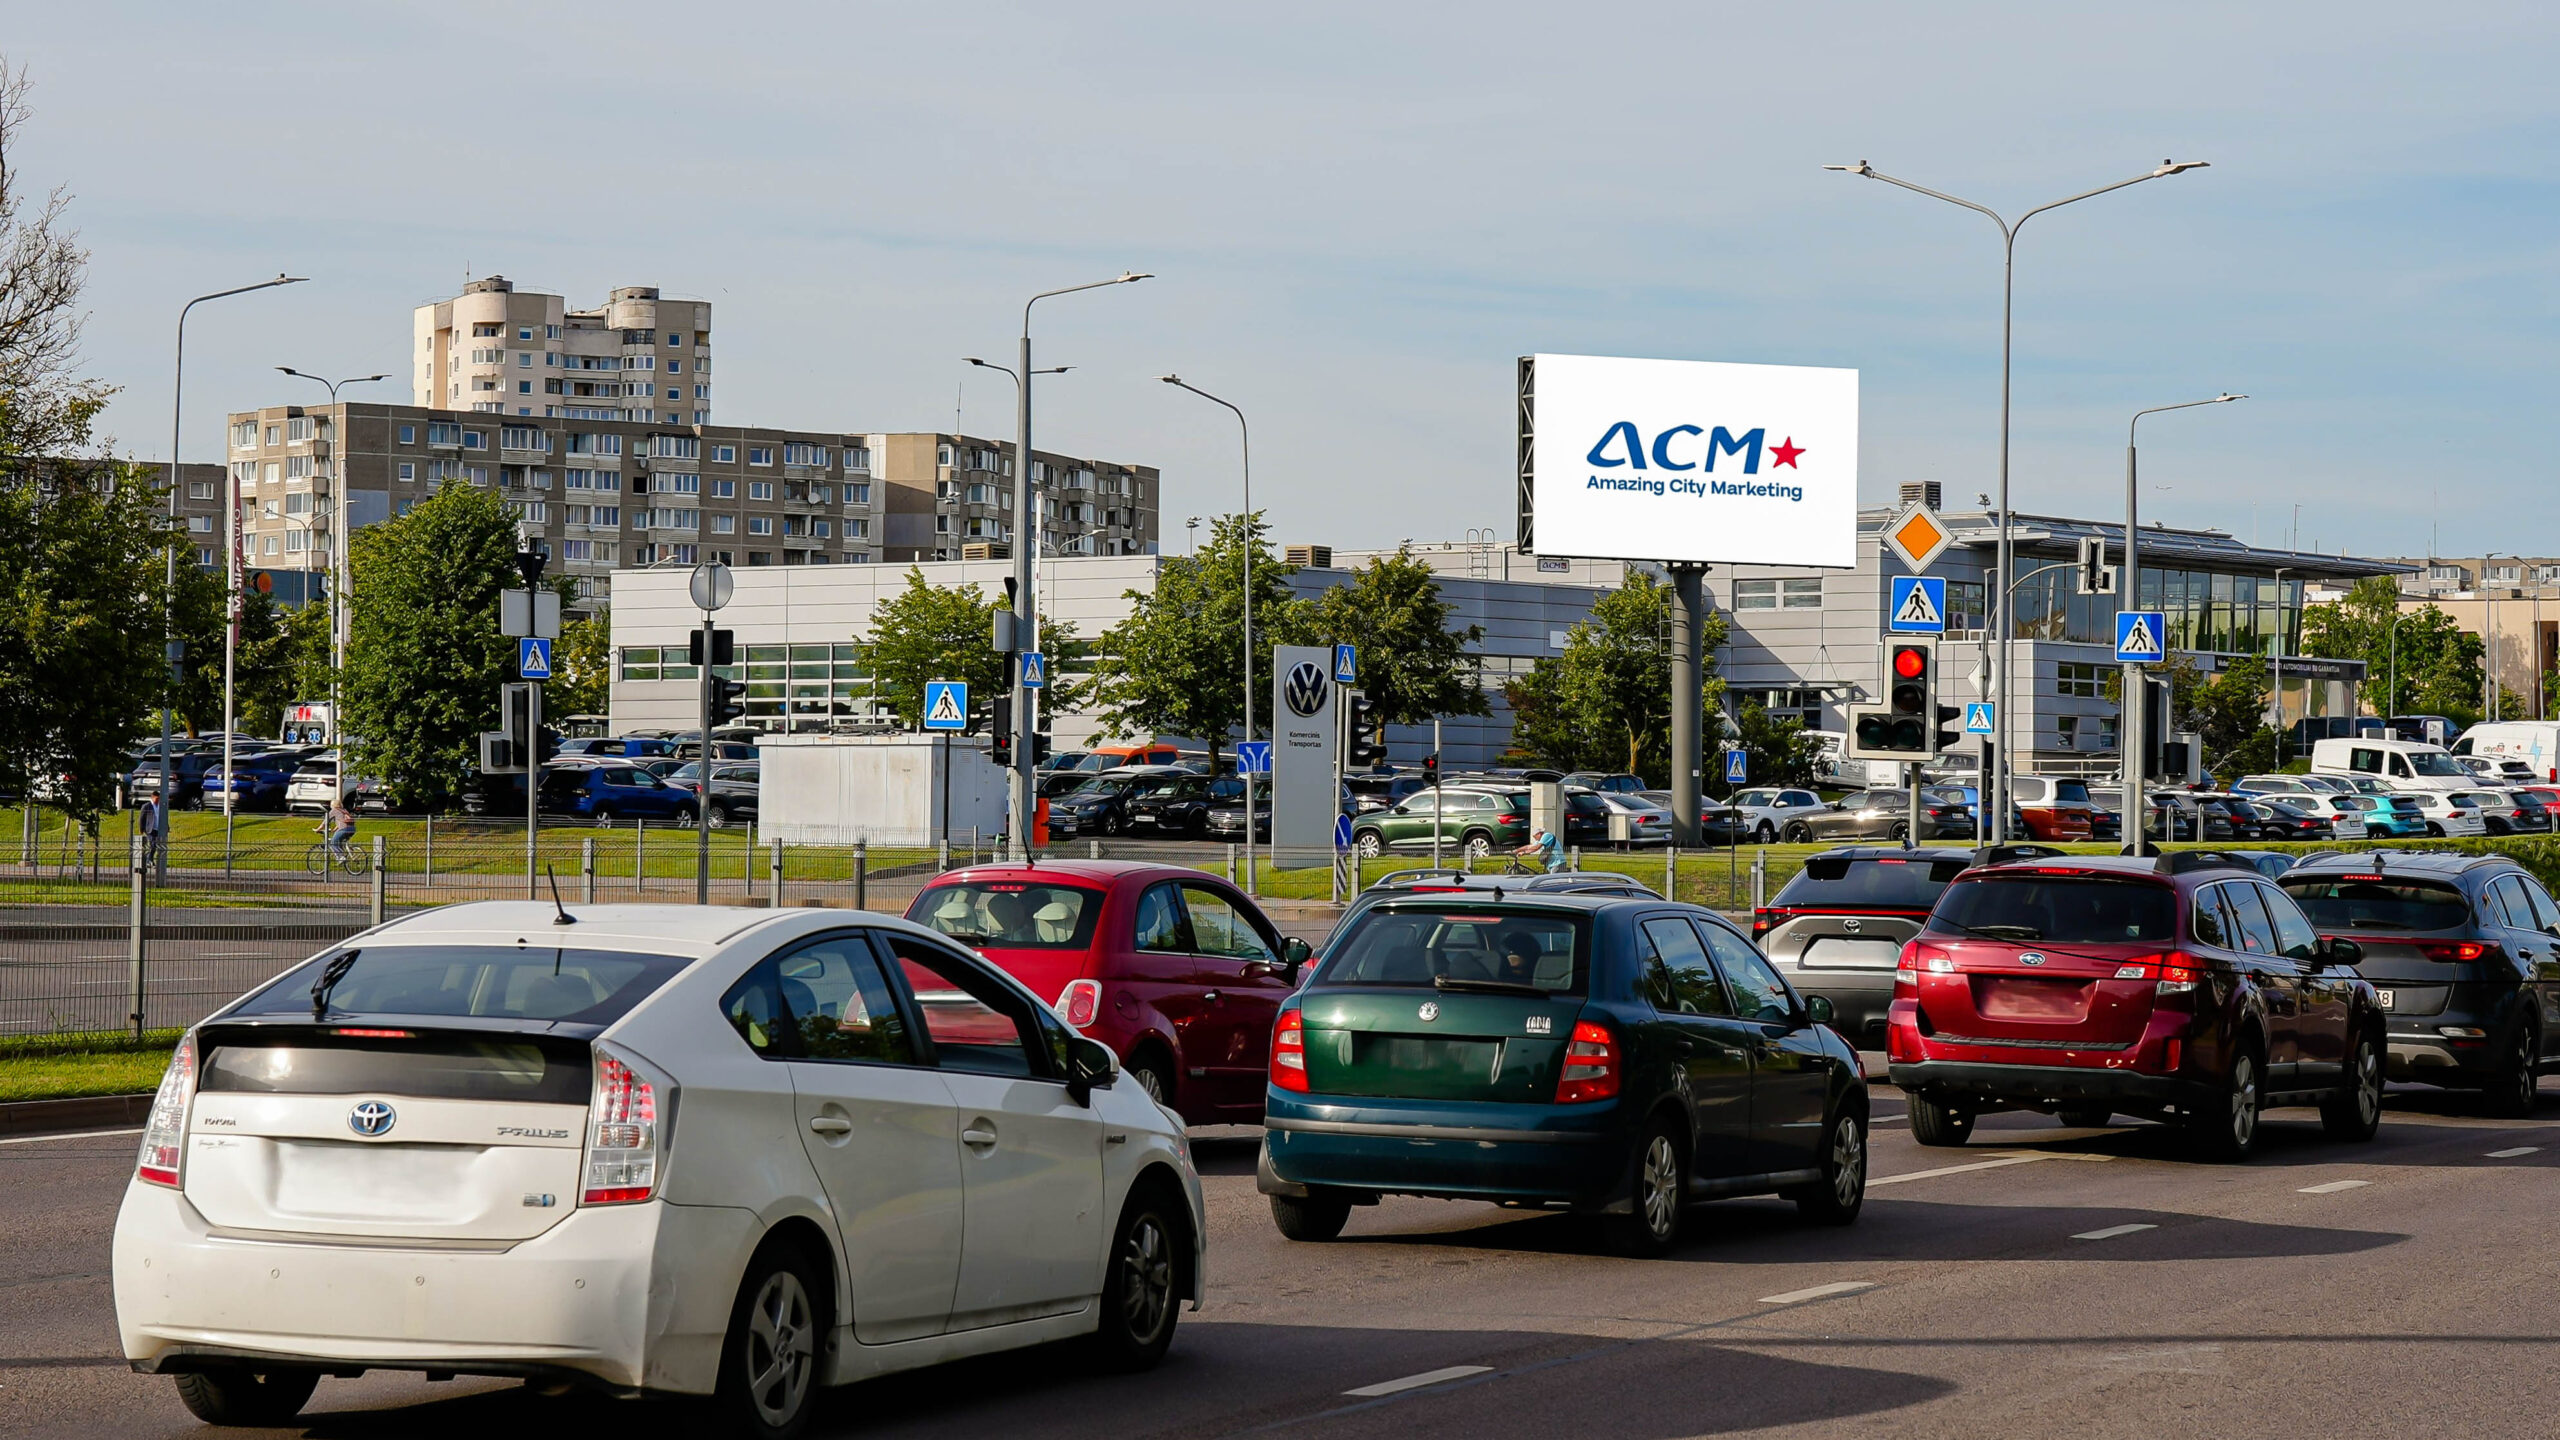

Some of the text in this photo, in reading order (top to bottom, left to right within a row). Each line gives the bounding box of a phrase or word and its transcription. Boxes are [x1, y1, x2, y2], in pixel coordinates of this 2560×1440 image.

[1587, 421, 1765, 474] ACM
[1587, 475, 1803, 502] Amazing City Marketing
[1289, 731, 1320, 739] Komercinis
[1288, 740, 1322, 748] Transportas
[497, 1127, 569, 1138] PRIUS
